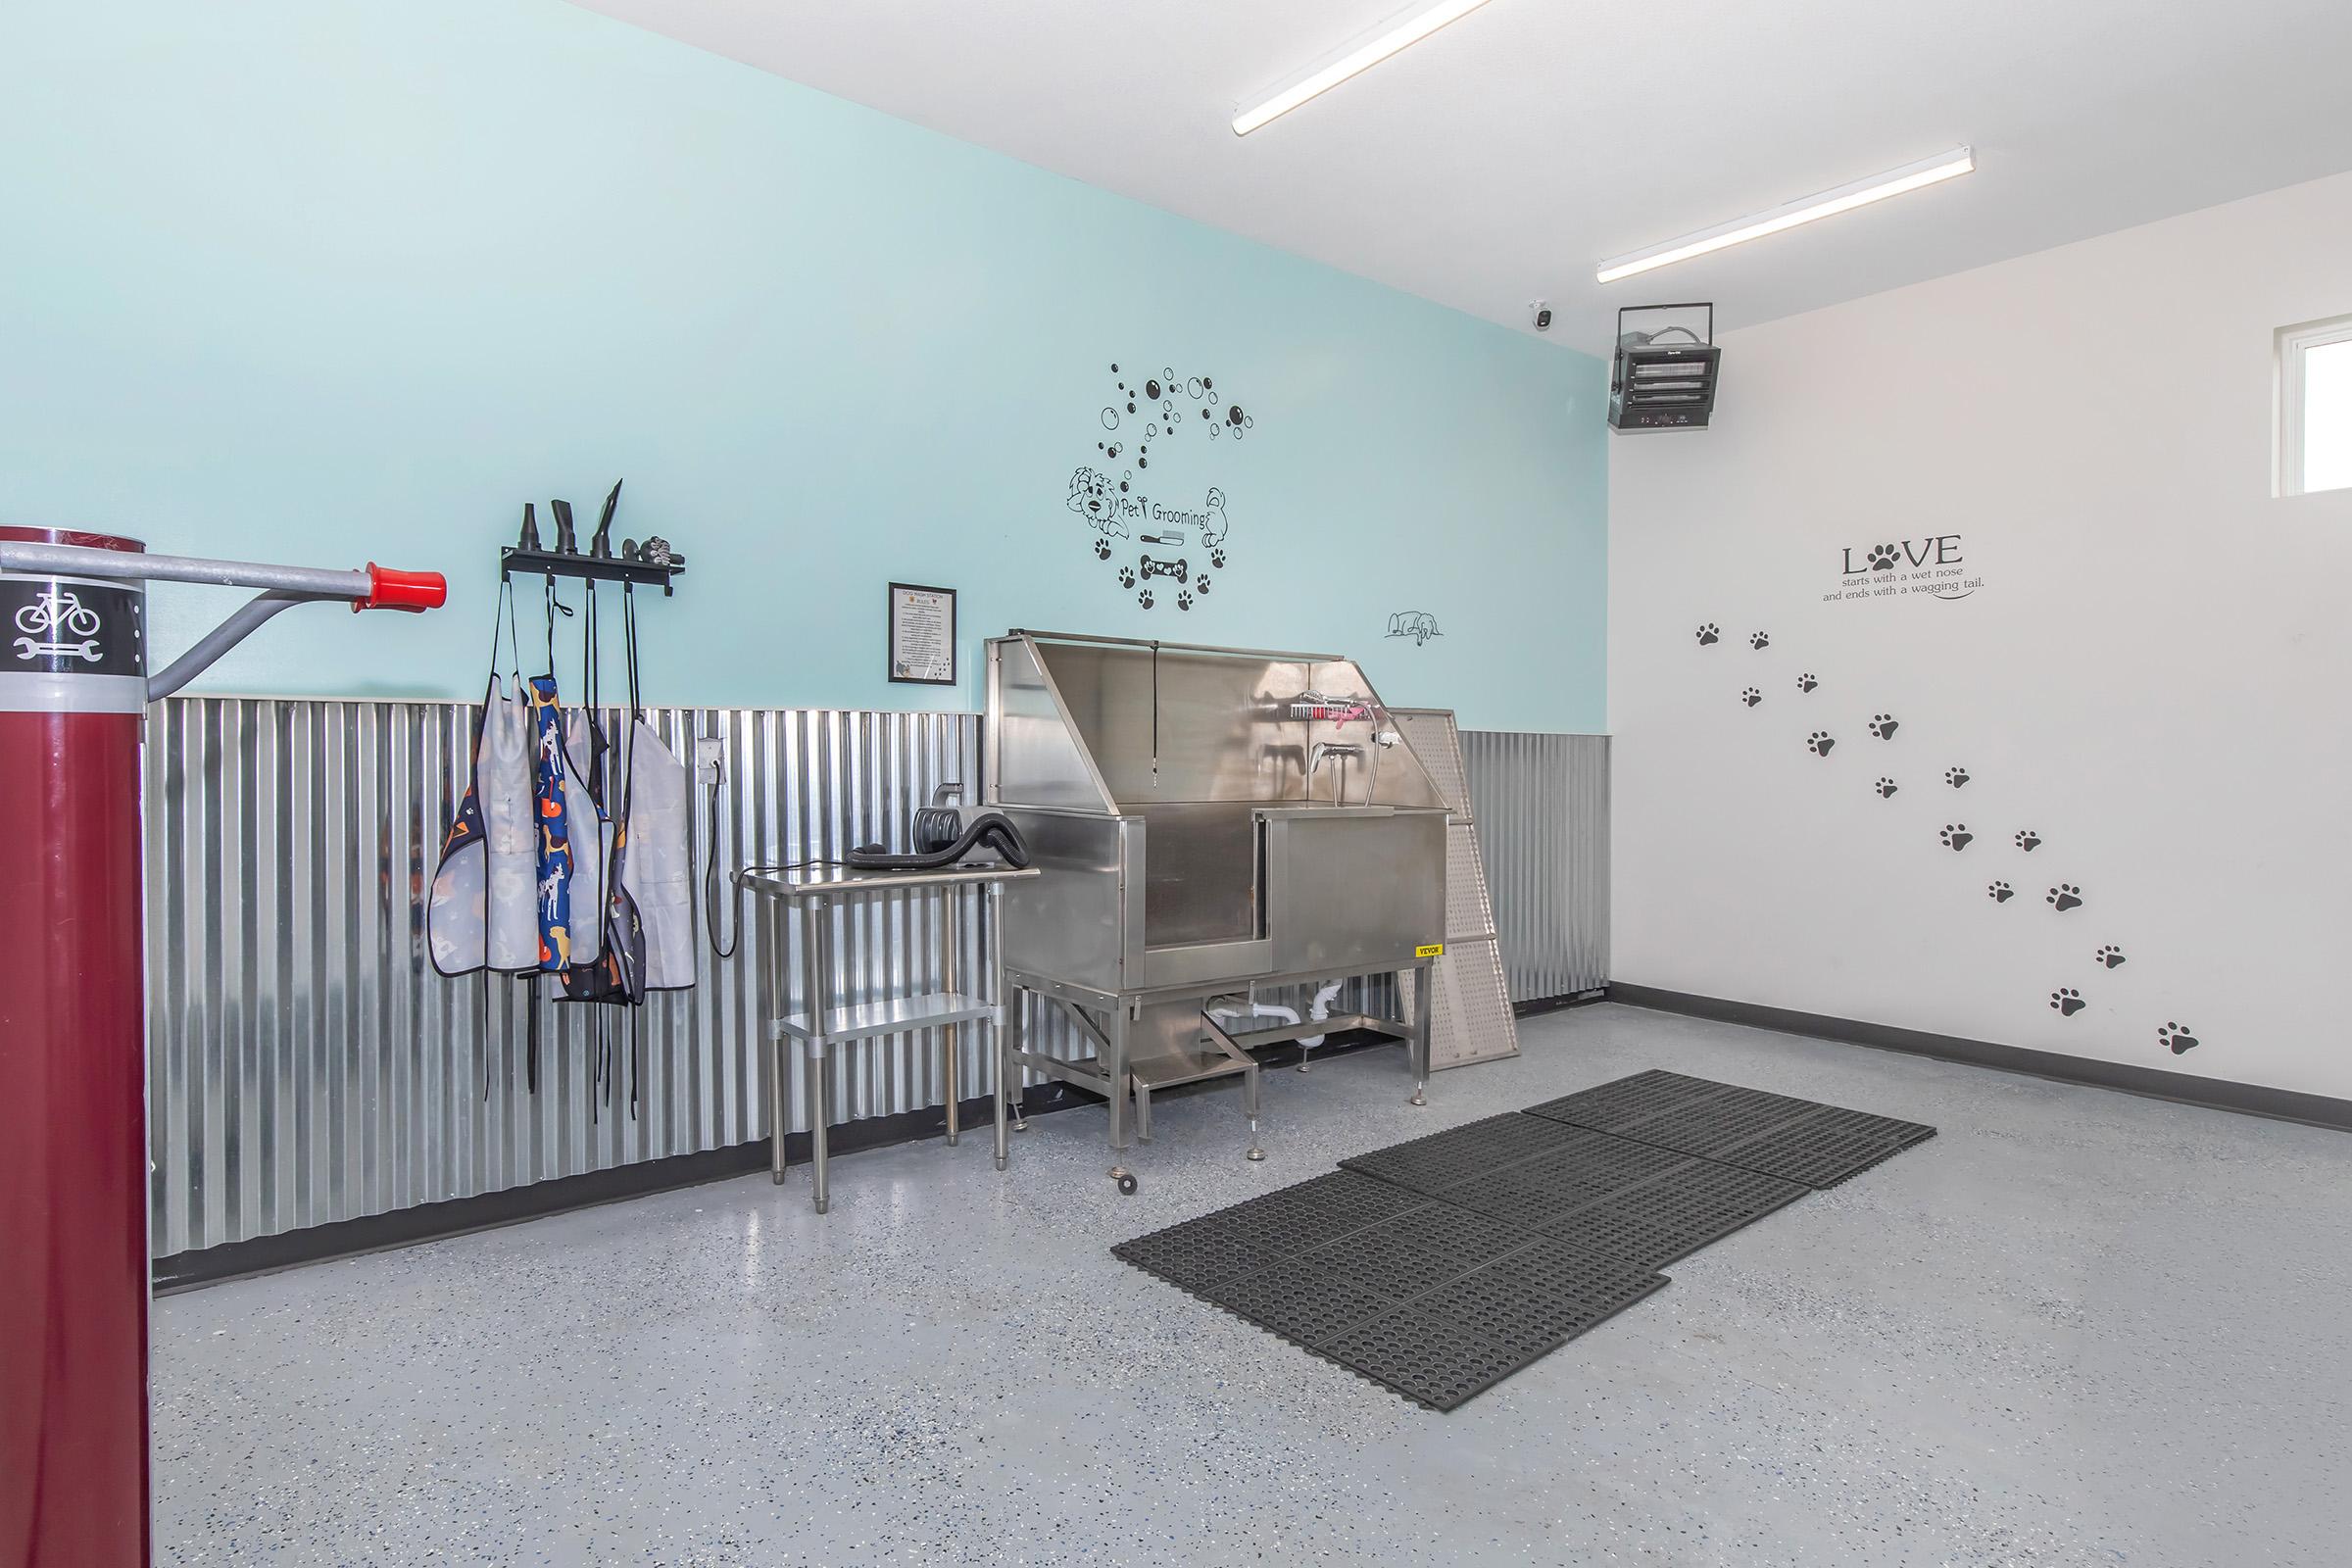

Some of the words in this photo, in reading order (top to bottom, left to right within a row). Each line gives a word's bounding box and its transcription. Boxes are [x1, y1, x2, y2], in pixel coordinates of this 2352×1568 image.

[1120, 498, 1140, 517] Pet
[1152, 503, 1206, 530] Grooming
[1823, 591, 1842, 602] and
[1845, 587, 1871, 600] ends
[1873, 584, 1897, 597] with
[1911, 580, 1960, 595] wagging
[1963, 577, 1984, 590] tail.
[1841, 576, 1870, 587] starts
[1873, 572, 1897, 584] with
[1911, 568, 1932, 580] wet
[1936, 567, 1964, 578] nose
